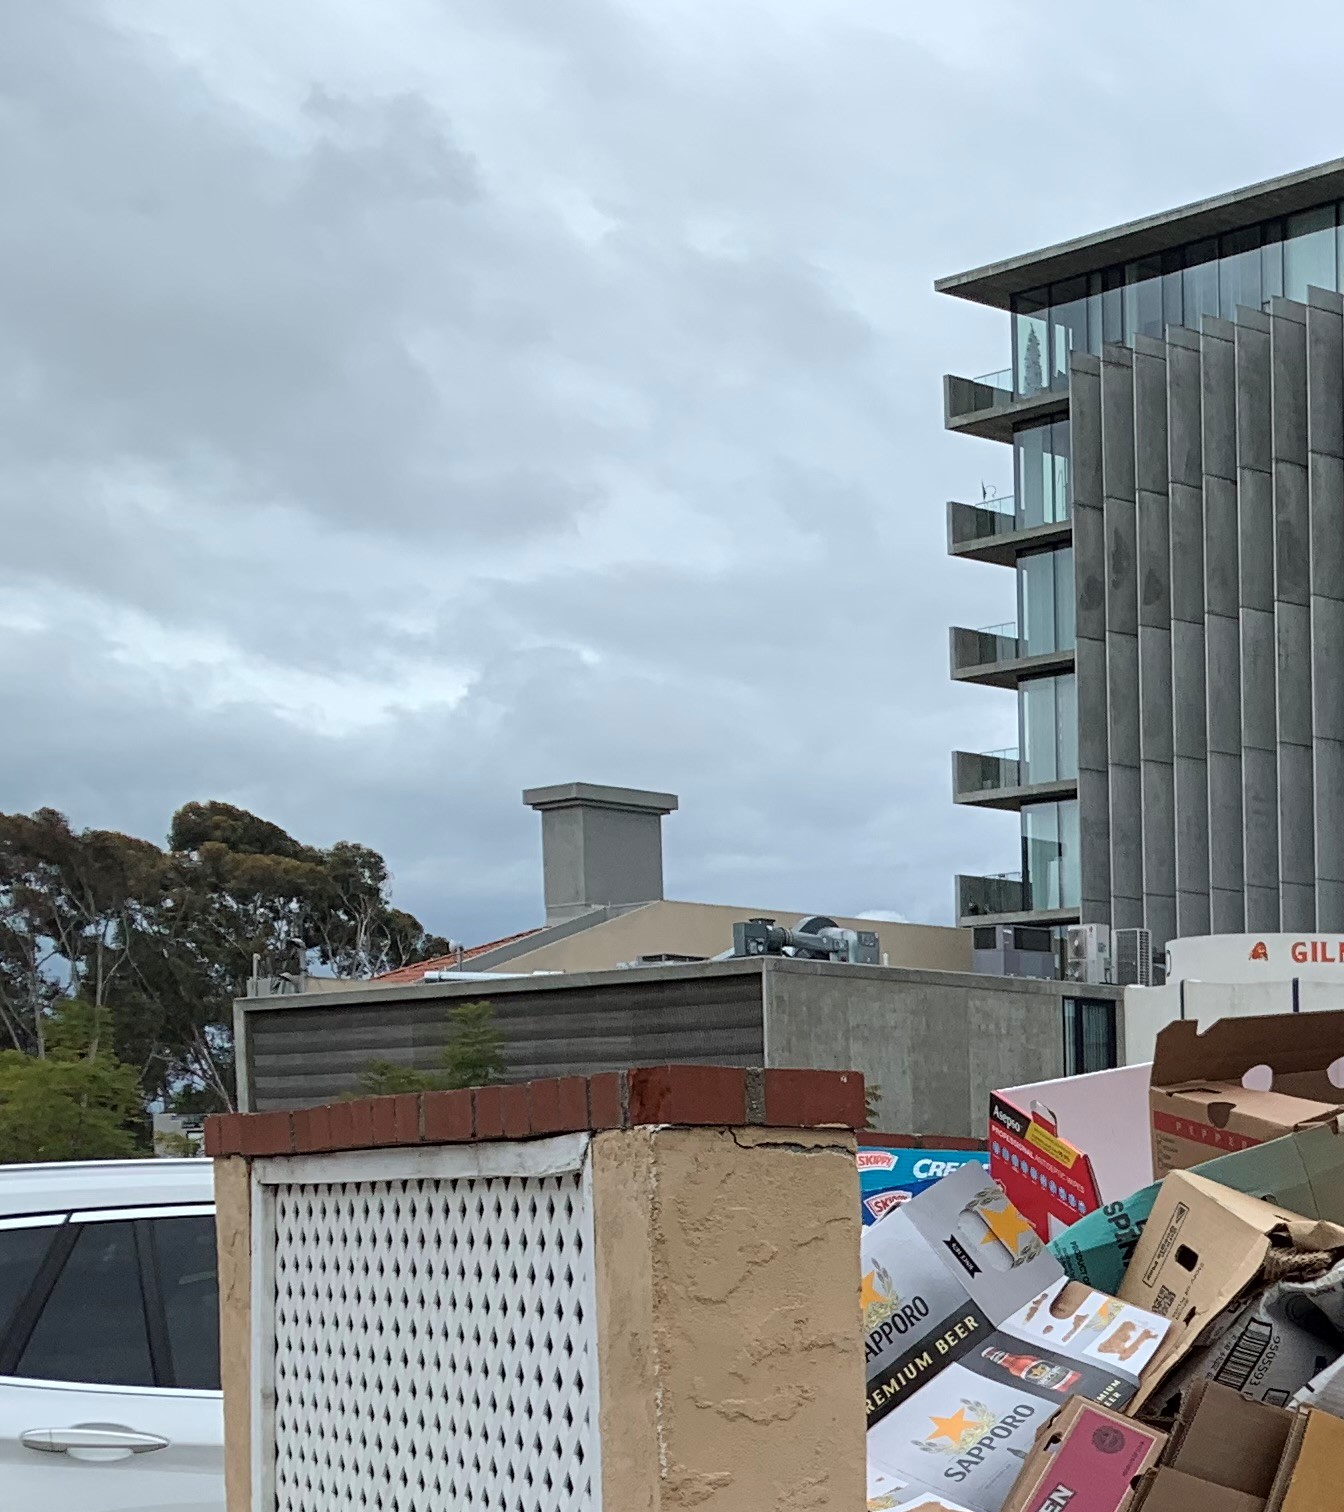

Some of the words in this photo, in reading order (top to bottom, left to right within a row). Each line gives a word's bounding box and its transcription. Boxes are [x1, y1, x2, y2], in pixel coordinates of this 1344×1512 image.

[993, 1104, 1021, 1133] Asepso
[1176, 1121, 1248, 1149] PEPPER
[991, 1124, 1035, 1160] PROFESSIONAL
[857, 1152, 894, 1170] SKIPPY
[1103, 1201, 1138, 1268] SPIN
[1069, 1240, 1088, 1278] PRODUCT
[864, 1295, 930, 1364] APPORO
[865, 1349, 933, 1415] REMIUM
[934, 1314, 980, 1356] BEER
[1249, 1335, 1281, 1387] 9505593
[1096, 1379, 1122, 1403] MIUM
[1104, 1391, 1122, 1408] EER
[944, 1403, 1036, 1483] SAPPORO
